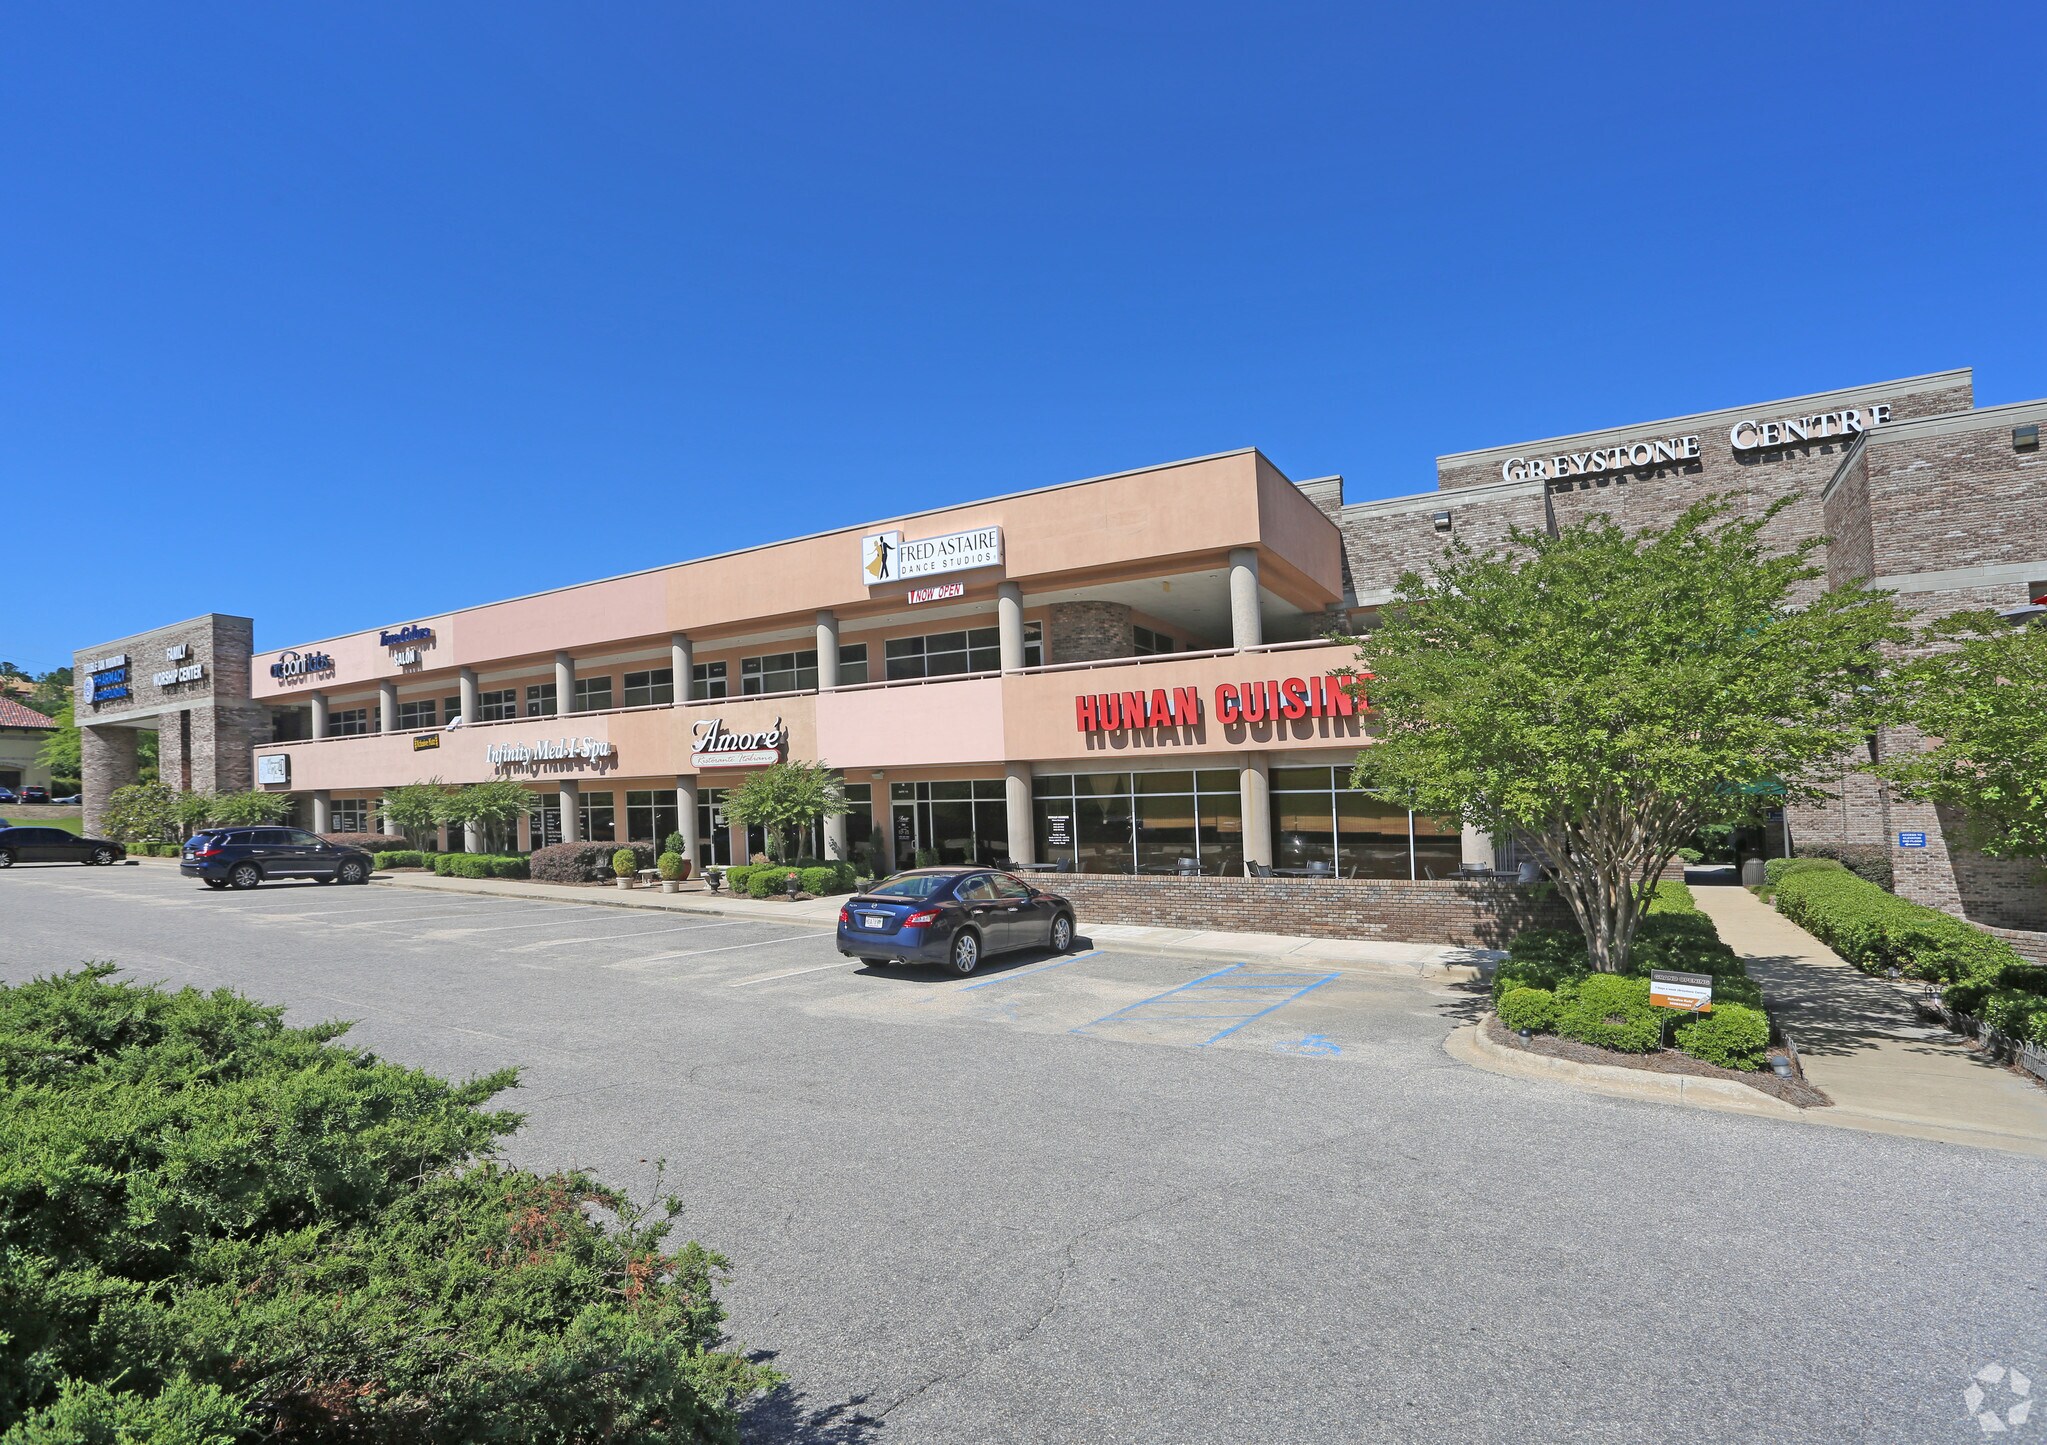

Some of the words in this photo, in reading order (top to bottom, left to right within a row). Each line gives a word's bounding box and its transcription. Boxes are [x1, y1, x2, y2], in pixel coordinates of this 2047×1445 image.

[1502, 435, 1700, 481] GREYSTONE
[1730, 404, 1892, 451] CENTRE
[900, 542, 935, 563] FRED
[938, 530, 997, 557] ASTAIRE
[902, 562, 935, 574] DANCE
[943, 553, 990, 567] STUDIOS
[938, 583, 961, 599] OPEN
[166, 644, 188, 662] FAMILY
[393, 649, 417, 667] SALON
[94, 668, 125, 686] PHARMACY
[152, 668, 178, 687] WORSHIP
[178, 664, 203, 682] CENTER
[1075, 685, 1199, 733] HUNAN
[690, 716, 782, 752] Amoré
[485, 742, 532, 766] Infinity
[1679, 977, 1710, 985] OPENING
